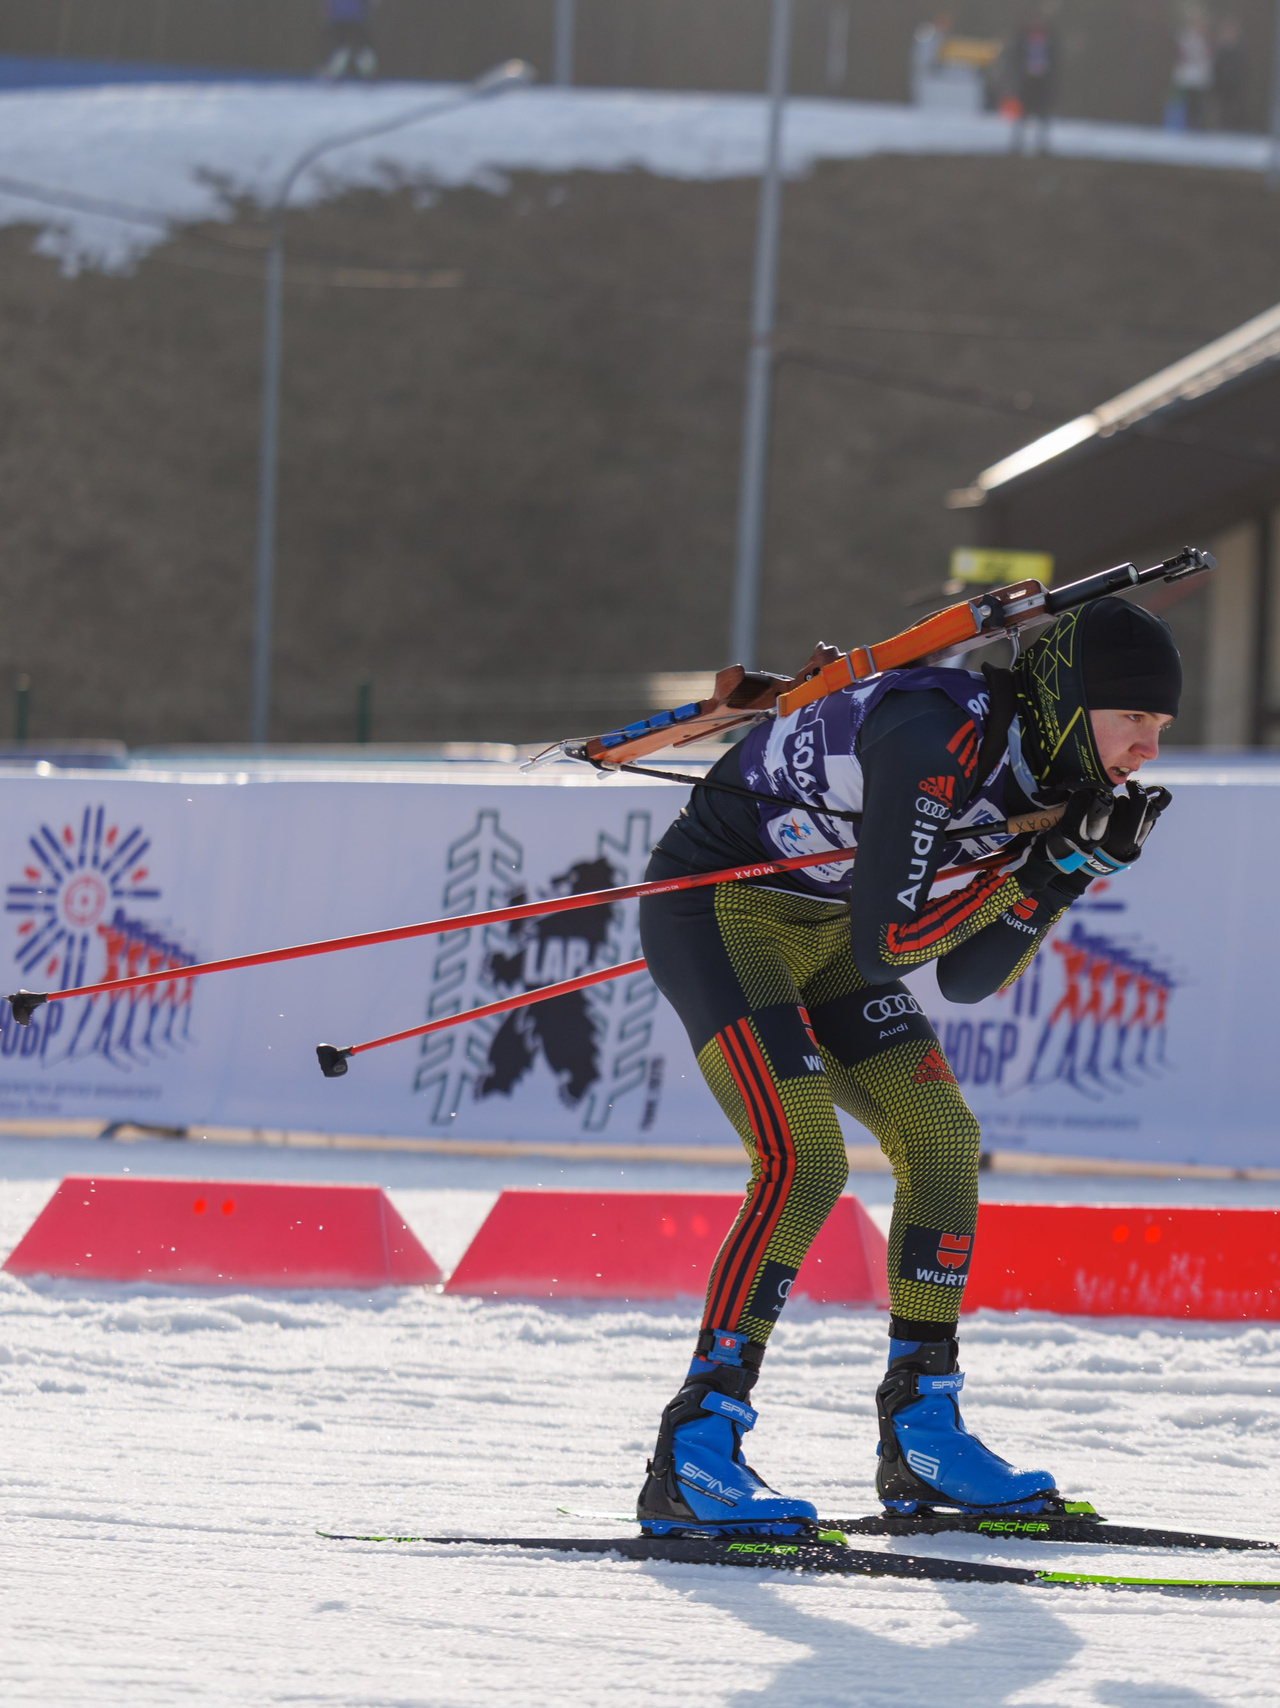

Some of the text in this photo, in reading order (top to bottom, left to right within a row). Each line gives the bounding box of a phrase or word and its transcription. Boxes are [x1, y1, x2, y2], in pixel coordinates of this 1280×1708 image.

[792, 730, 817, 788] 506
[734, 865, 775, 880] MOAX
[896, 820, 939, 912] Audi
[524, 936, 590, 985] LAP
[879, 1023, 909, 1039] Audi
[931, 1378, 964, 1390] SPINE
[720, 1400, 754, 1423] SPINE
[680, 1461, 746, 1500] SPINE
[977, 1521, 1050, 1533] FISCHER
[727, 1543, 799, 1556] FISCHER
